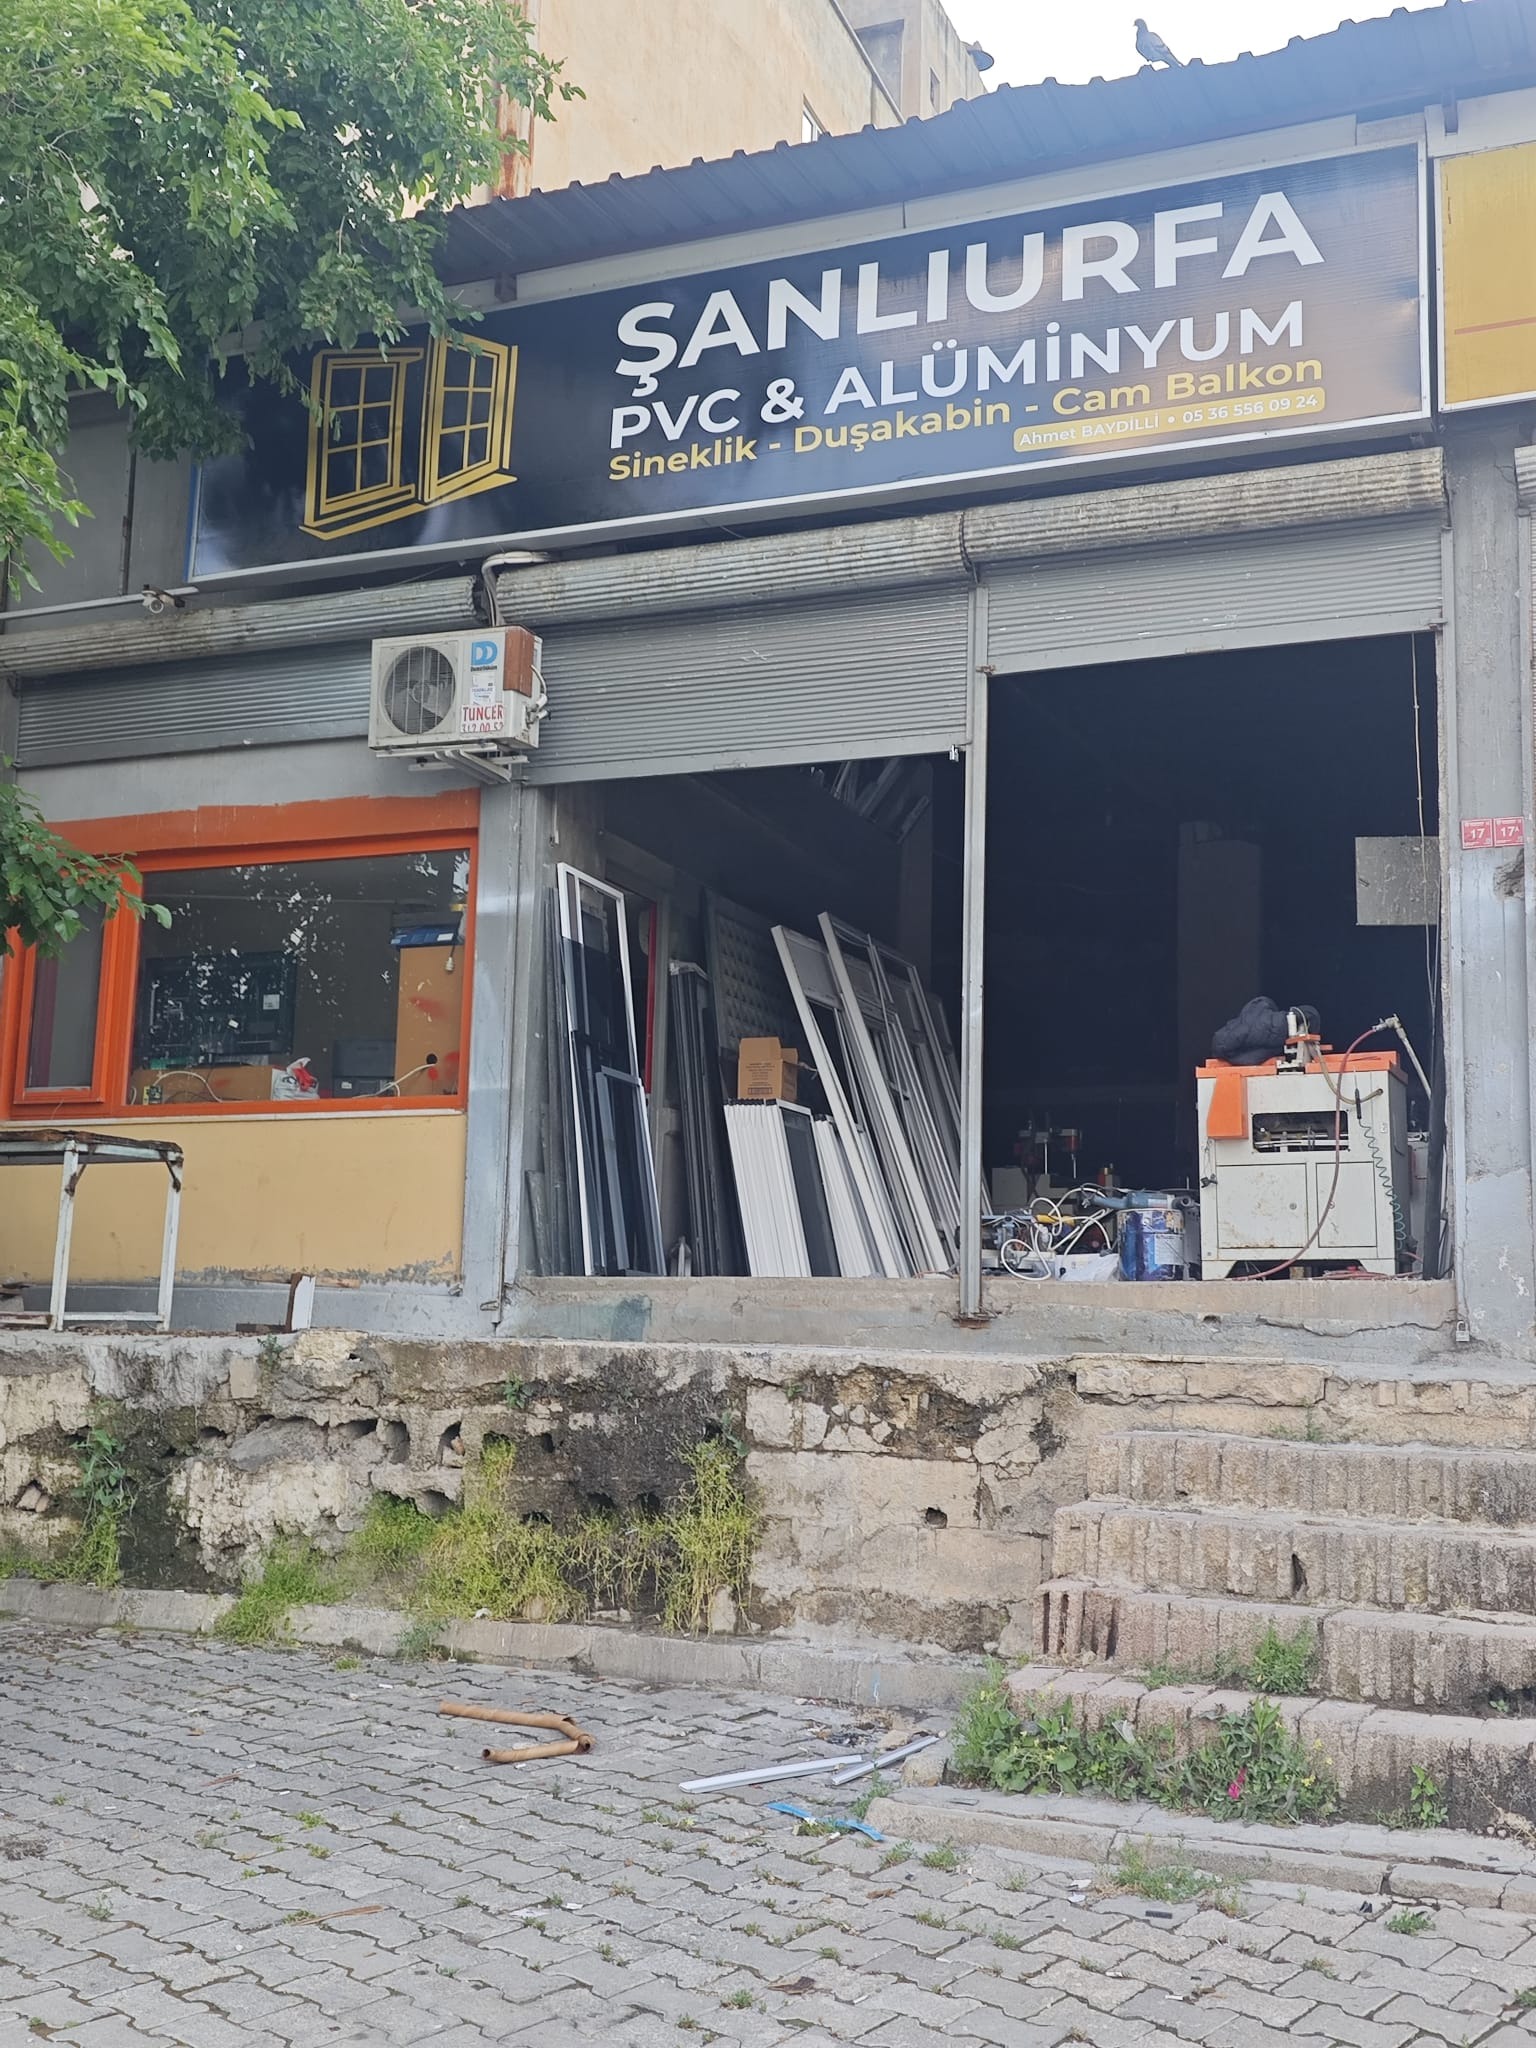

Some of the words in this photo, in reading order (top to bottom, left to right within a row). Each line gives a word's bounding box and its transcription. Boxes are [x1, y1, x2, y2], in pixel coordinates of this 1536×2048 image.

[615, 191, 1325, 397] ŞANLIURFA
[608, 435, 758, 481] Sineklik
[794, 398, 1011, 453] Duşakabin
[1052, 383, 1151, 416] Cam
[1166, 359, 1323, 401] Balkon
[610, 388, 742, 449] PVC
[760, 378, 805, 424] &
[823, 300, 1303, 415] ALÜMİNYUM
[1019, 428, 1077, 447] Ahmet
[1081, 411, 1160, 439] BAYDİLLİ
[1182, 409, 1203, 424] 05
[1207, 406, 1228, 421] 36
[1233, 402, 1264, 418] 556
[1268, 399, 1291, 413] 09
[1296, 395, 1319, 408] 24
[1470, 828, 1485, 839] 17
